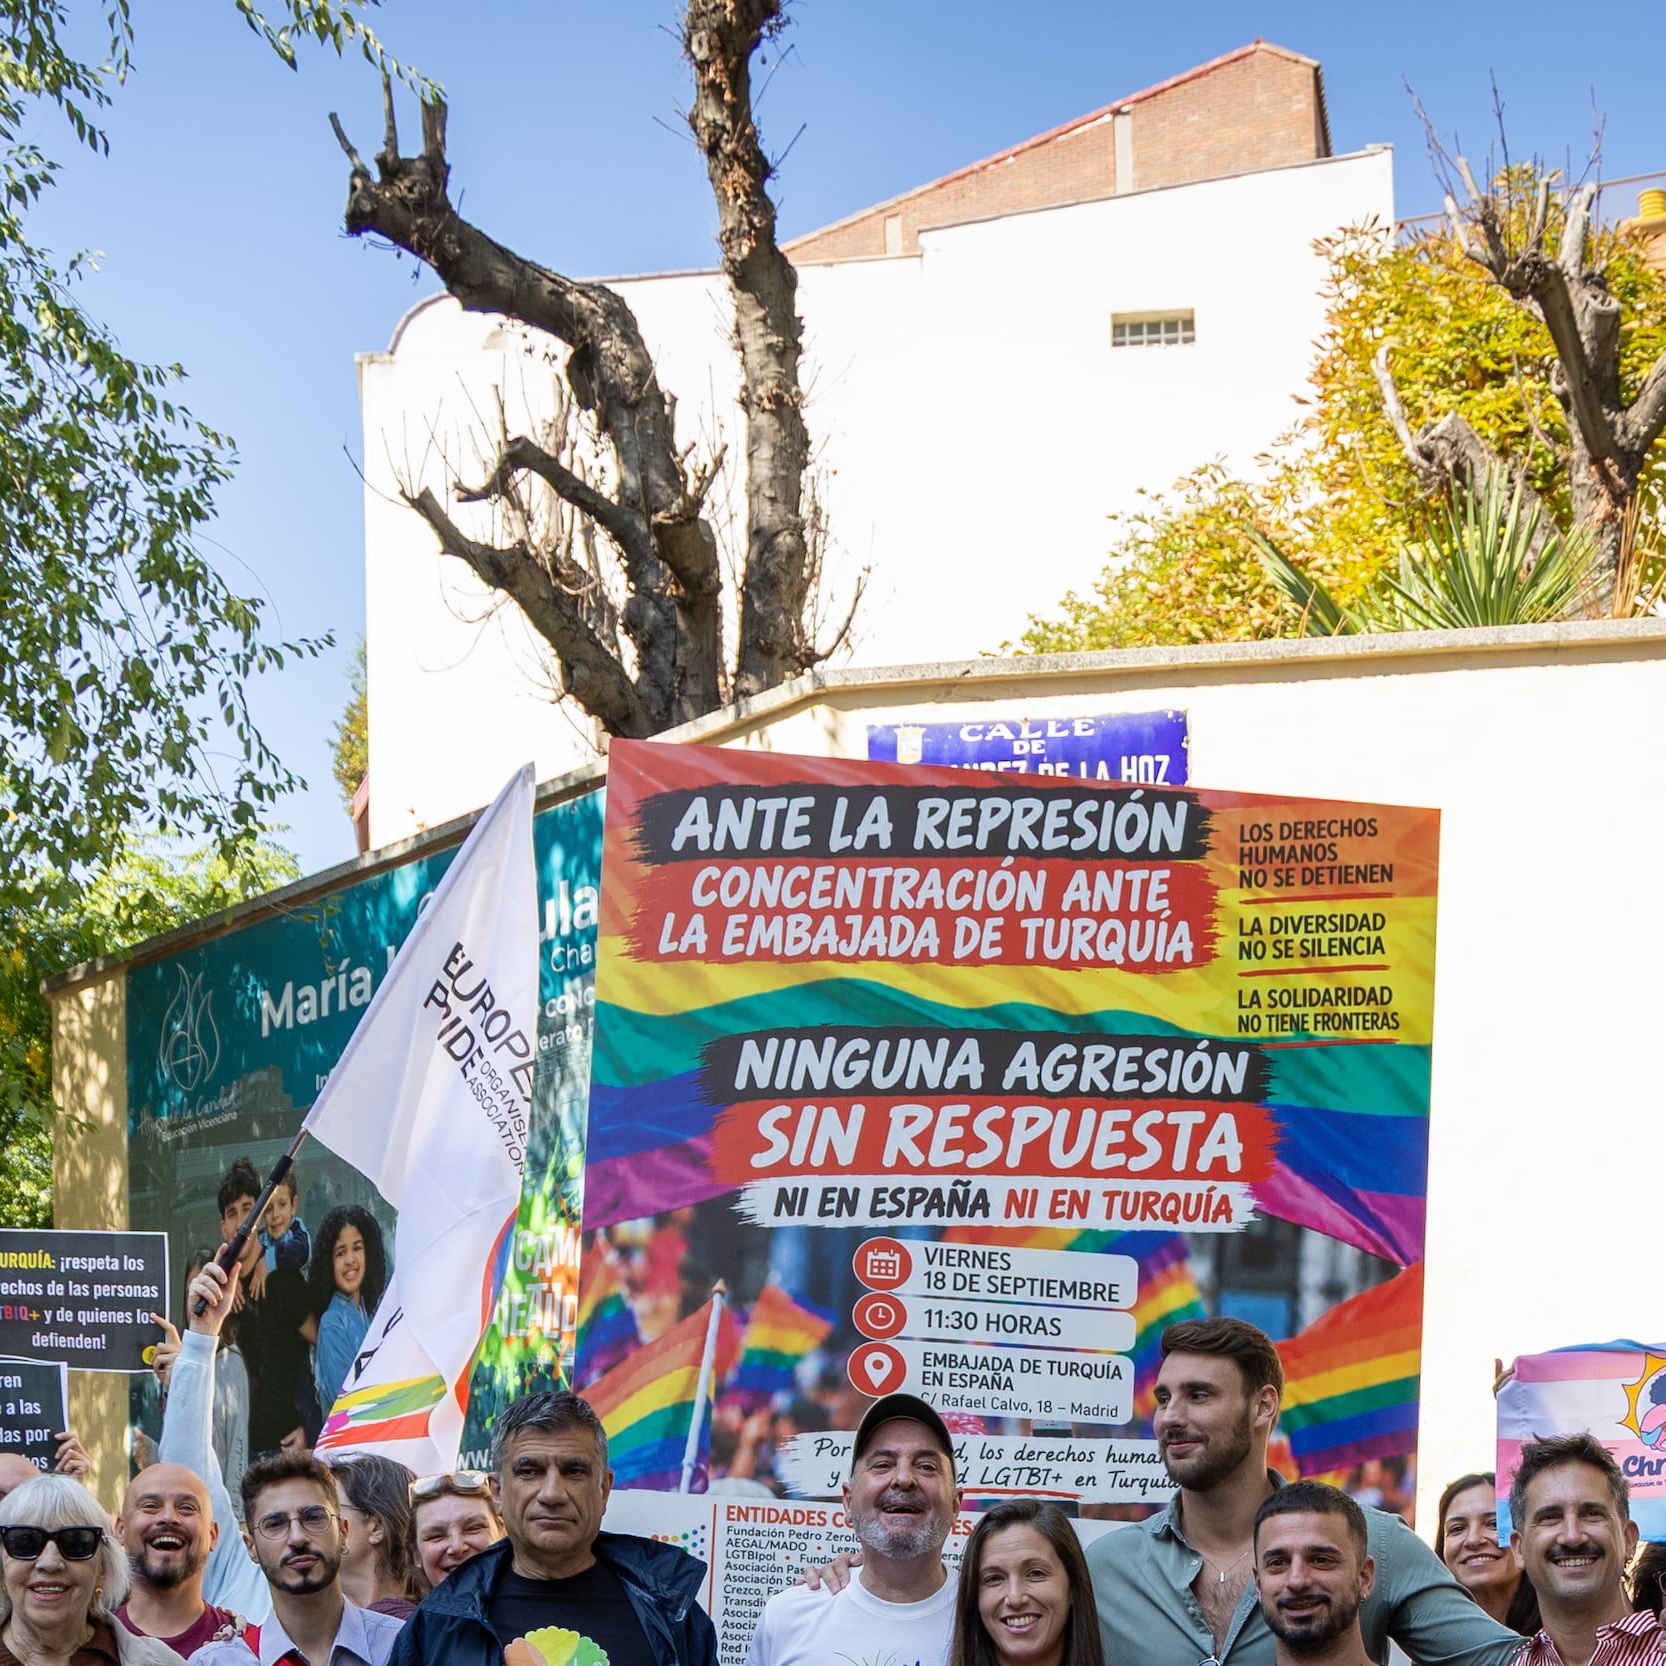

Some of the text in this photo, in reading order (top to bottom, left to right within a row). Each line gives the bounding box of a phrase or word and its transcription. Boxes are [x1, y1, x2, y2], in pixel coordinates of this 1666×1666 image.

[959, 718, 1096, 742] CALLE
[1012, 739, 1046, 756] DE
[1121, 754, 1171, 786] HOZ
[671, 788, 1188, 853] ANTE LA REPRESIÓN
[1239, 818, 1378, 843] LOS DERECHOS
[1239, 843, 1338, 866] HUMANOS
[691, 856, 1171, 913] CONCENTRACIÓN ANTE
[1239, 863, 1393, 889] NO SE DETIENEN
[1239, 912, 1386, 937] LA DIVERSIDAD
[657, 909, 1194, 965] LA EMBAJADA DE TURQUÍA
[1238, 936, 1386, 960] NO SE SILENCIA
[261, 957, 373, 1038] María
[1238, 986, 1393, 1009] LA SOLIDARIDAD
[423, 979, 485, 1080] PRIDE
[443, 941, 535, 1103] EUROPE
[1238, 1011, 1400, 1033] NO TIENE FRONTERAS
[733, 1036, 1251, 1096] NINGUNA AGRESIÓN
[749, 1103, 1245, 1174] SIN RESPUESTA
[773, 1179, 1235, 1225] NI EN ESPAÑA NI EN TURQUÍA
[60, 1255, 119, 1274] ¡respeta
[123, 1255, 145, 1271] los
[923, 1247, 1012, 1271] VIERNES
[47, 1280, 64, 1296] de
[68, 1280, 90, 1296] las
[93, 1284, 159, 1300] personas
[923, 1270, 1120, 1303] 18 DE SEPTIEMBRE
[44, 1309, 52, 1325] y
[56, 1307, 73, 1322] de
[78, 1308, 133, 1326] quienes
[136, 1308, 155, 1324] los
[924, 1308, 1062, 1337] 11:30 HORAS
[32, 1332, 106, 1349] defienden!
[923, 1351, 1123, 1381] EMBAJADA DE TURQUÍA
[922, 1371, 1014, 1392] EN ESPAÑA
[6, 1402, 15, 1416] a
[20, 1399, 42, 1415] las
[941, 1393, 986, 1409] Rafael
[991, 1396, 1033, 1415] Calvo,
[1037, 1400, 1053, 1414] 18
[1070, 1402, 1118, 1418] Madrid
[25, 1428, 50, 1445] por
[814, 1438, 851, 1458] Por
[980, 1442, 1005, 1461] los
[1014, 1439, 1096, 1464] derechos
[827, 1469, 841, 1489] y
[980, 1467, 1064, 1487] LGTBI+
[1075, 1474, 1096, 1488] en
[726, 1505, 827, 1527] ENTIDADES
[725, 1538, 808, 1551] AEGAL/MADO
[726, 1526, 822, 1541] Fundación Pedro
[725, 1550, 776, 1562] LGTBIpol
[725, 1561, 783, 1573] Asociación
[724, 1573, 783, 1585] Asociación
[724, 1585, 763, 1597] Crezco,
[721, 1643, 742, 1653] Red
